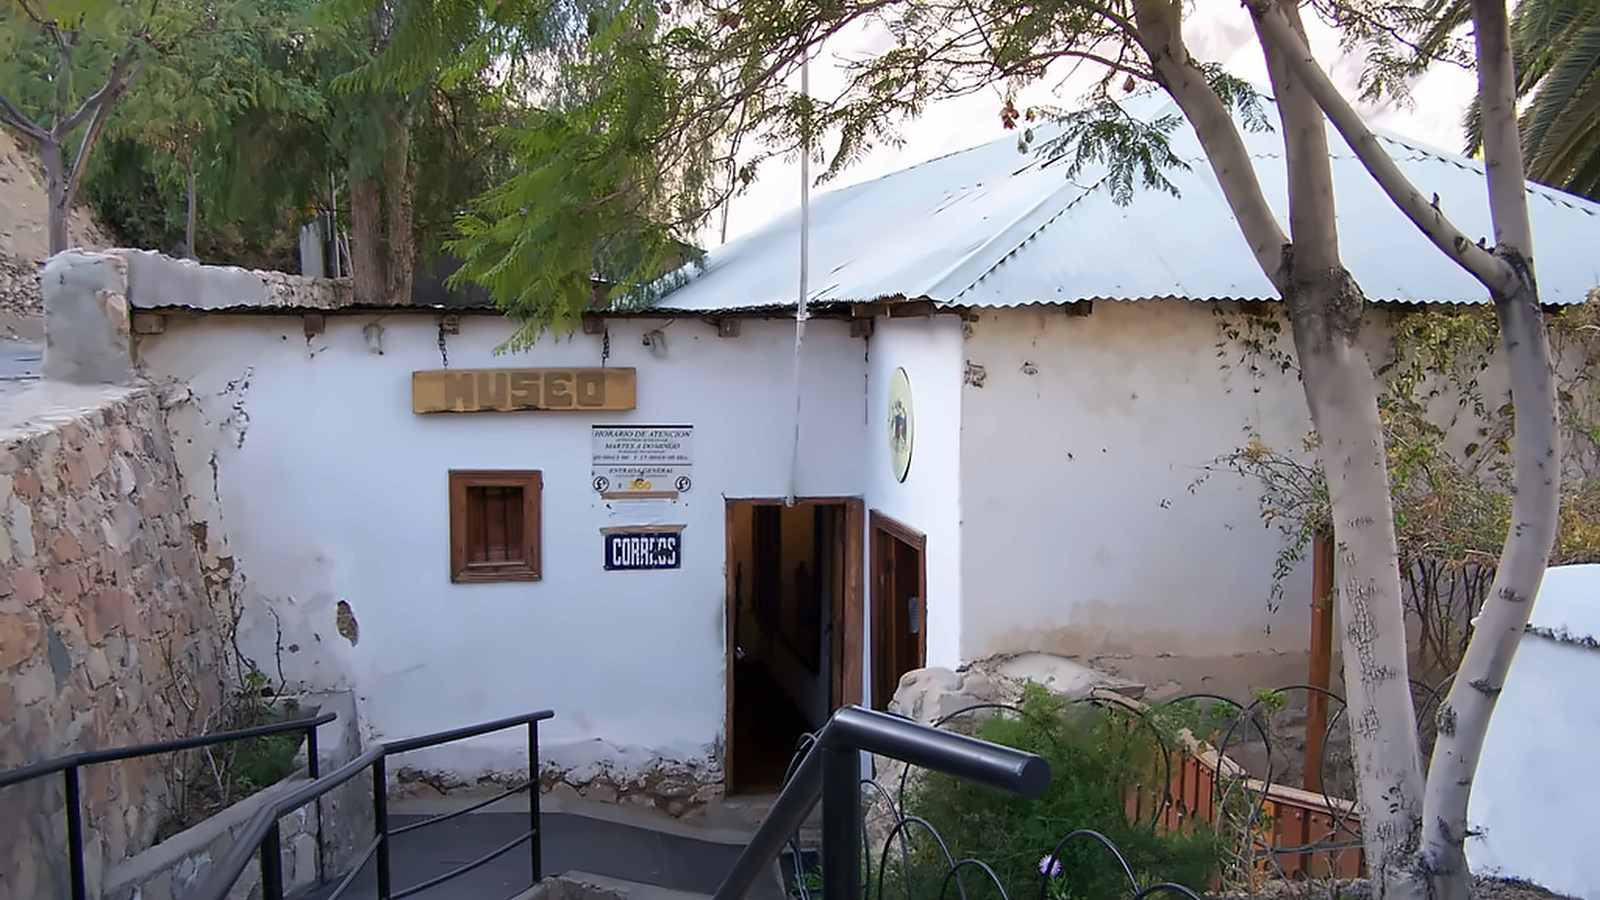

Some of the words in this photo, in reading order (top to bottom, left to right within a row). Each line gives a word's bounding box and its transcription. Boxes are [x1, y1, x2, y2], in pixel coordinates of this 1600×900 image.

[445, 372, 606, 409] MUSEO
[594, 430, 633, 438] HORARIO
[634, 430, 646, 438] DE
[612, 537, 676, 566] CORREOS
